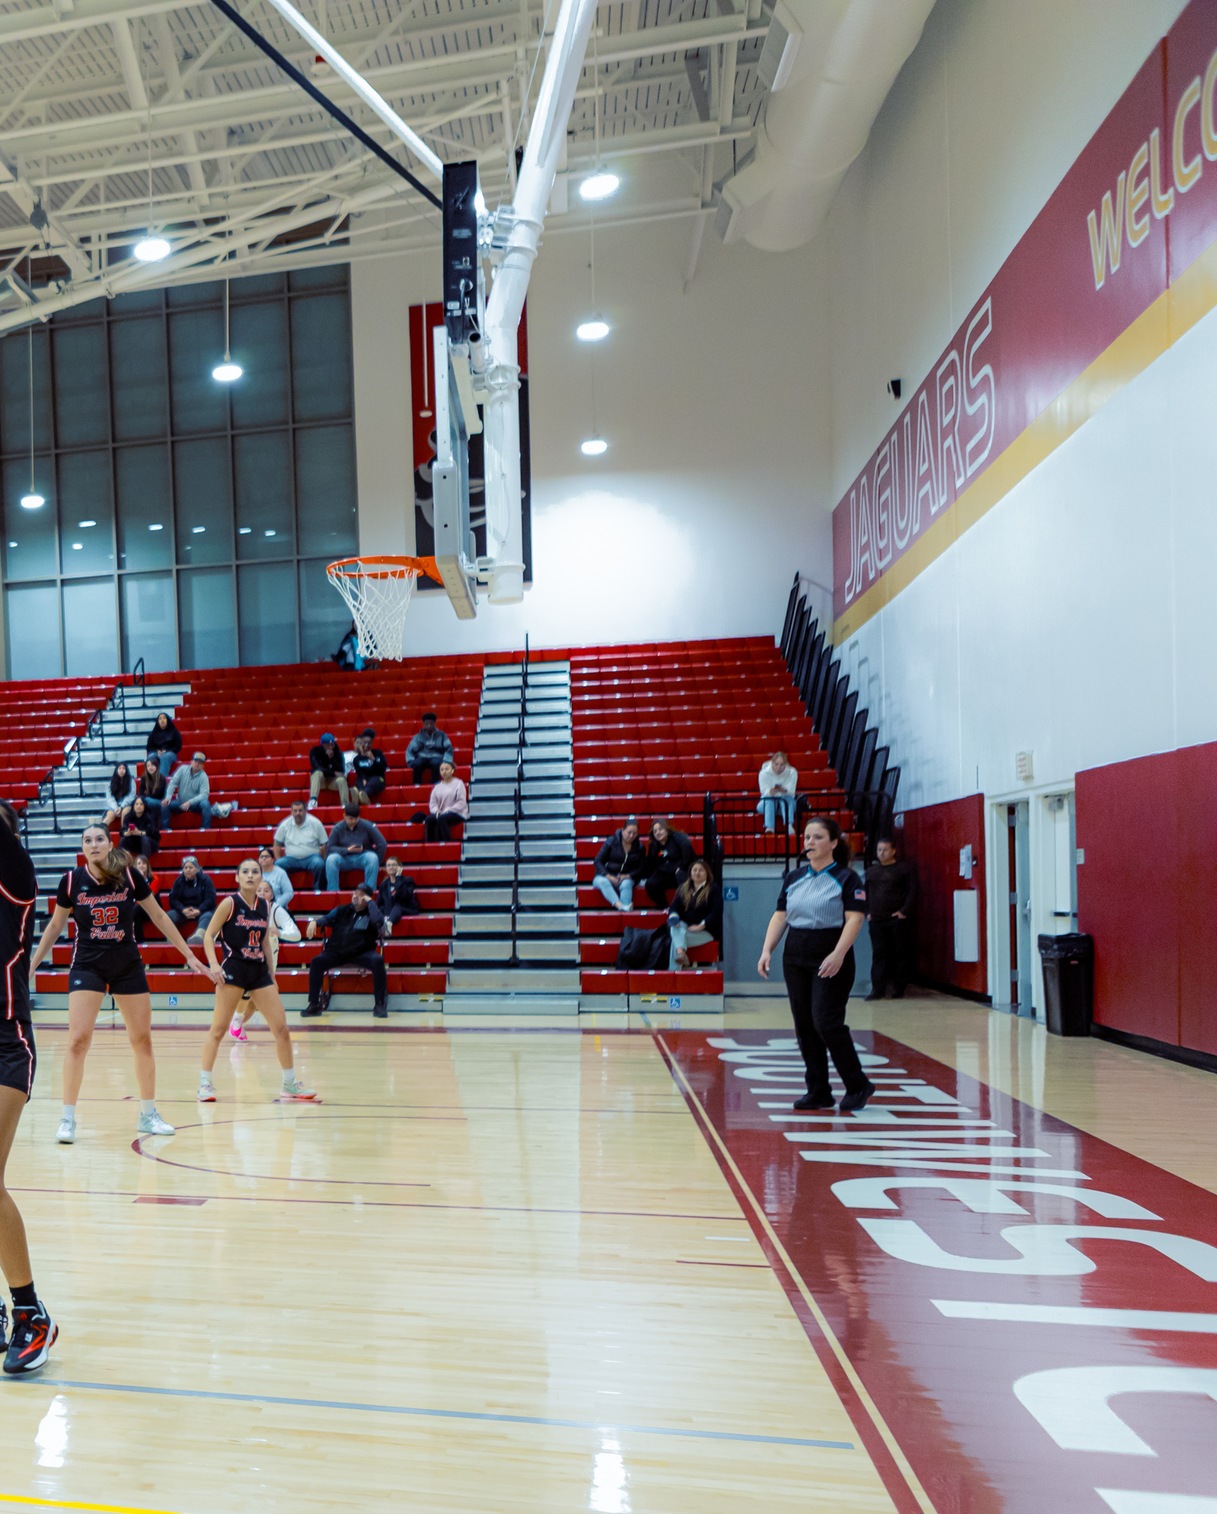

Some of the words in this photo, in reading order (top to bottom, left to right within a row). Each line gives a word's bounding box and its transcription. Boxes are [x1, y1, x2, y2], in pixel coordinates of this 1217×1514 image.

[844, 295, 996, 605] JAGUARS
[77, 887, 130, 908] Imperial
[91, 906, 119, 926] 32
[235, 914, 269, 930] Imperia
[248, 930, 261, 947] 11
